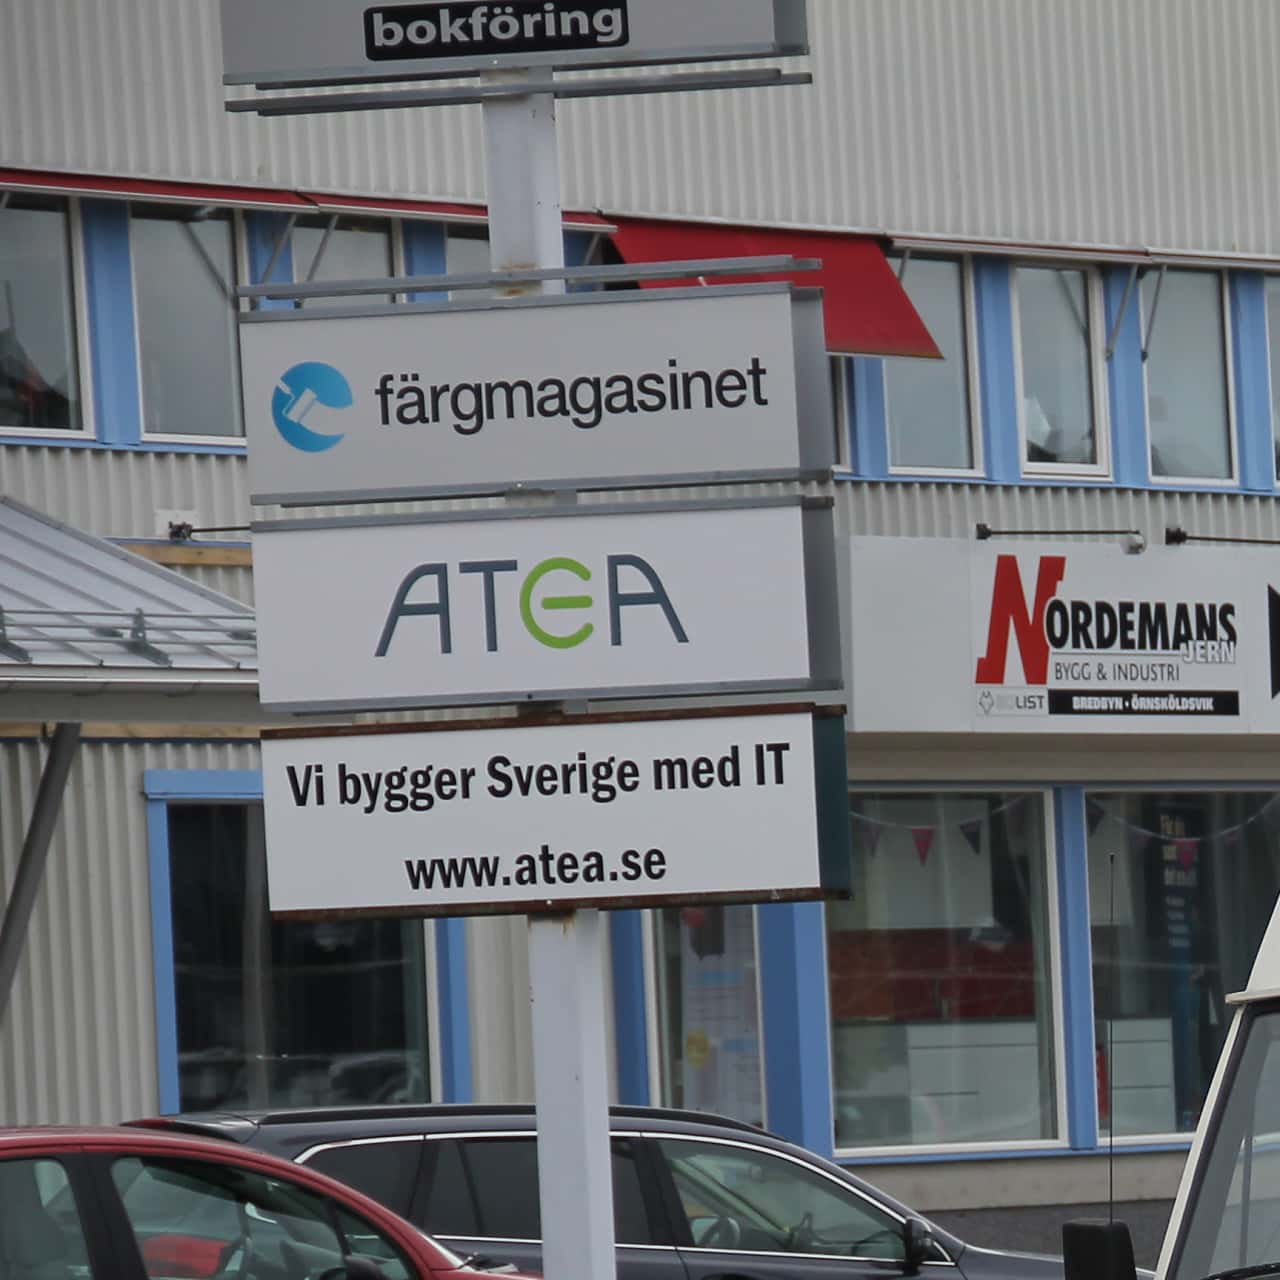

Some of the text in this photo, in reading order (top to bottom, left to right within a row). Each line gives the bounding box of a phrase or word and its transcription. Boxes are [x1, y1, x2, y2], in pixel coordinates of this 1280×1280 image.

[372, 2, 622, 46] bokföring
[374, 357, 768, 436] färgmagasinet
[374, 553, 689, 657] ATEA
[976, 555, 1238, 684] NORDEMANS
[1055, 663, 1180, 682] BYGG & INDUSTRI
[1072, 694, 1215, 712] BREDBYN ÖRNSKÖLDSVIK
[286, 742, 790, 814] Vi bygger Sverige med IT
[405, 844, 666, 889] www.atea.se
